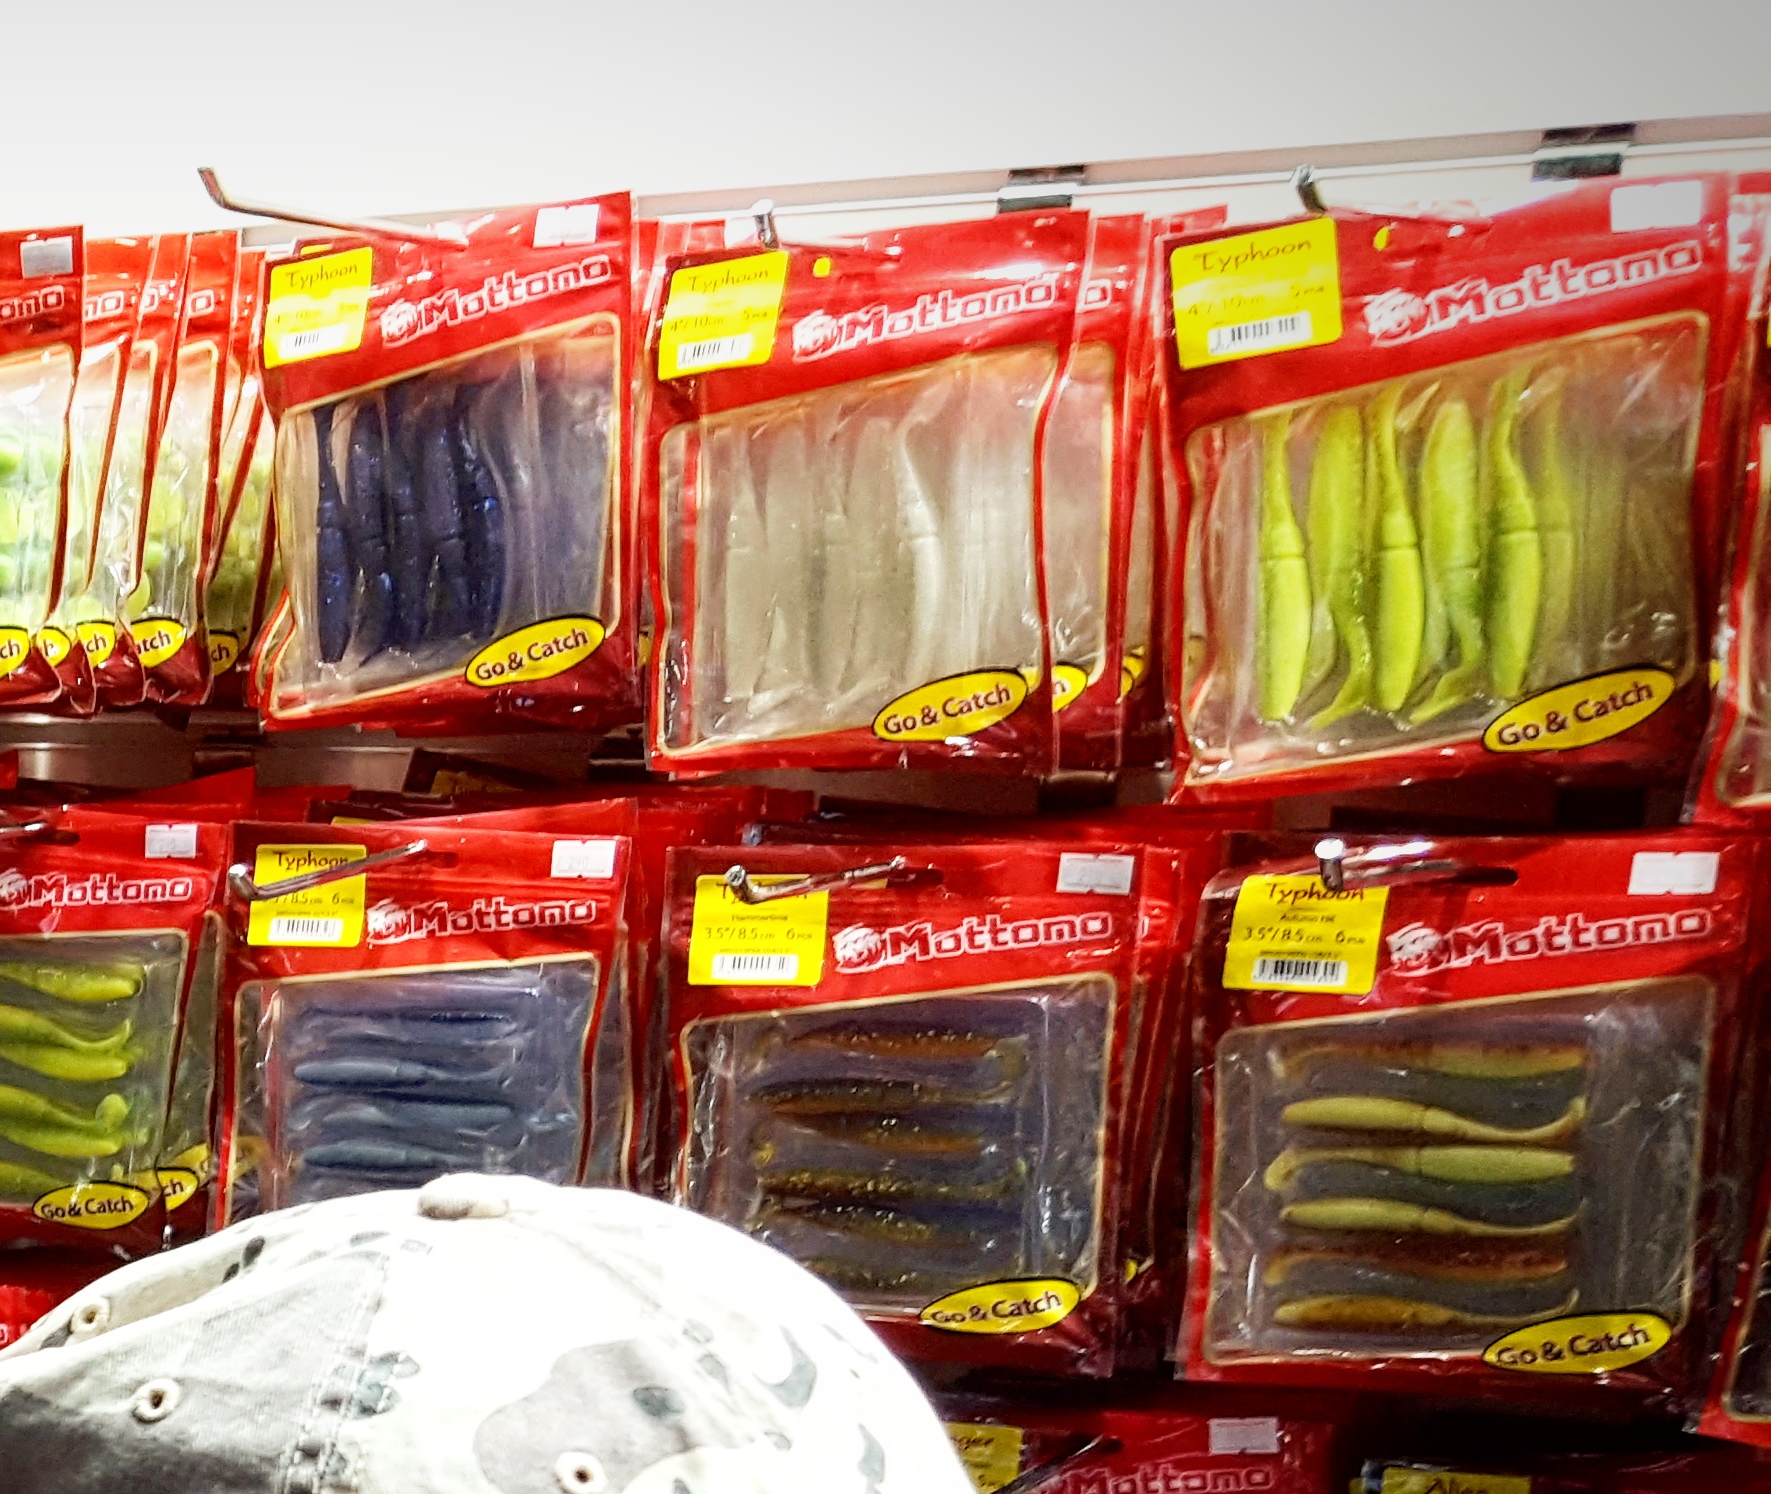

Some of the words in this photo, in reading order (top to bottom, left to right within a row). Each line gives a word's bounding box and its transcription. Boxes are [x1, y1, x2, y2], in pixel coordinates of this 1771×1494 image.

[1194, 235, 1311, 274] Typhoon
[286, 262, 357, 290] Typhoon
[688, 267, 769, 295] Typhoon
[475, 661, 506, 681] Go
[508, 652, 525, 670] &
[527, 628, 589, 661] Catch
[883, 712, 916, 734] Go
[919, 704, 938, 725] &
[941, 685, 1012, 715] Catch
[1498, 722, 1541, 745] Go
[1545, 711, 1567, 732] &
[1572, 681, 1655, 720] Catch
[84, 1197, 135, 1216] Catch
[990, 1291, 1063, 1318] Catch
[1499, 1349, 1538, 1365] Go
[1569, 1323, 1650, 1356] Catch
